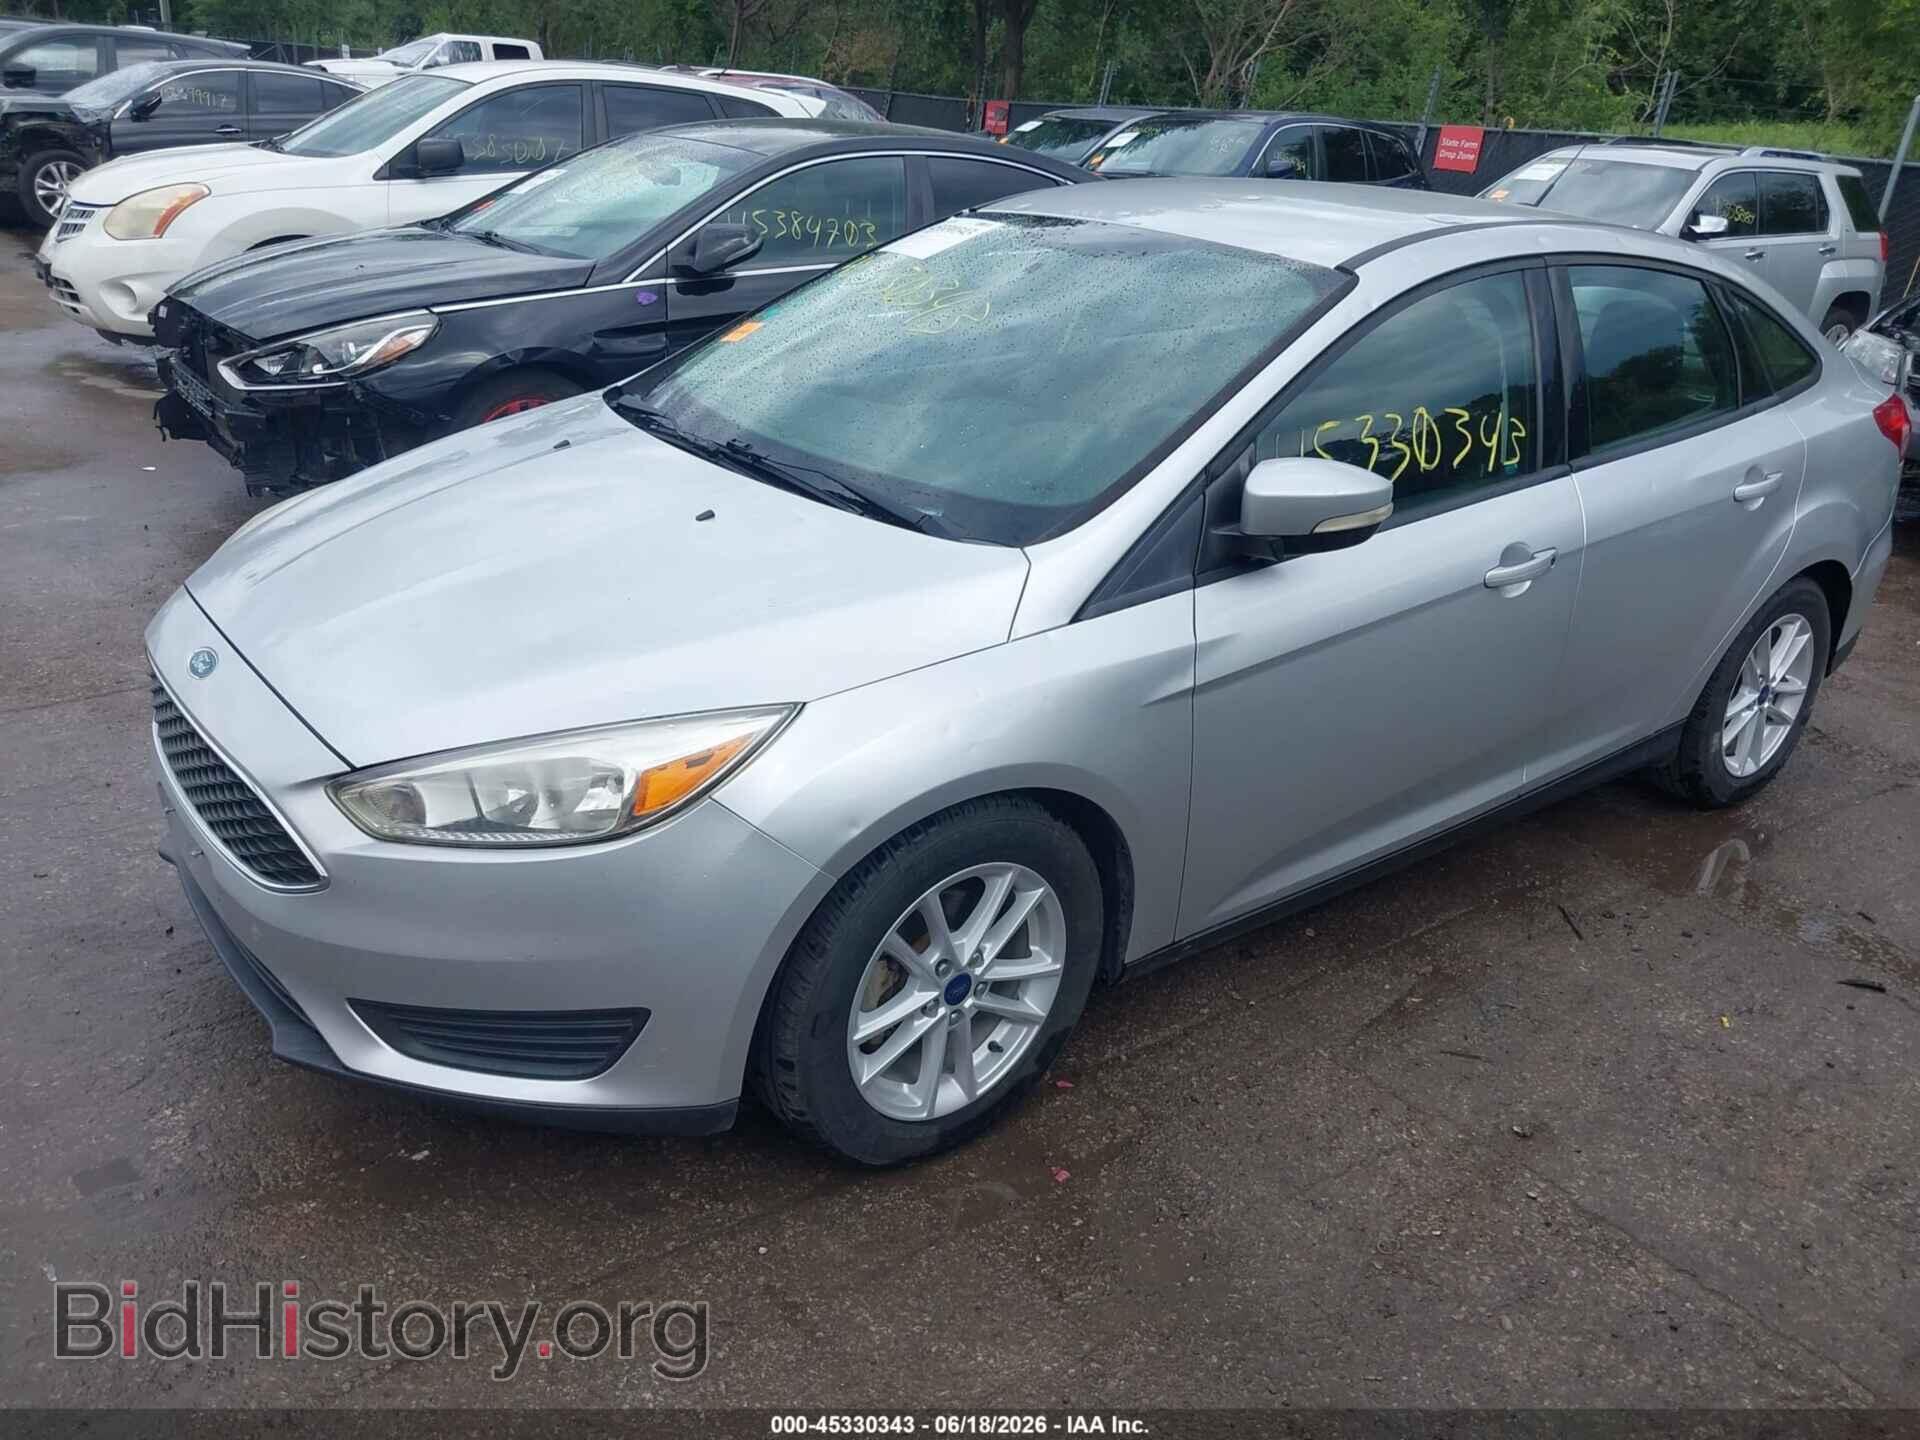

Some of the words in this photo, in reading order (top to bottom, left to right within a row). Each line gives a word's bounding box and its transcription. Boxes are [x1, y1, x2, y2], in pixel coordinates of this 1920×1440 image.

[1441, 137, 1460, 147] State
[1460, 139, 1479, 149] Farm
[1440, 149, 1457, 160] Drop
[1457, 151, 1475, 160] Zone
